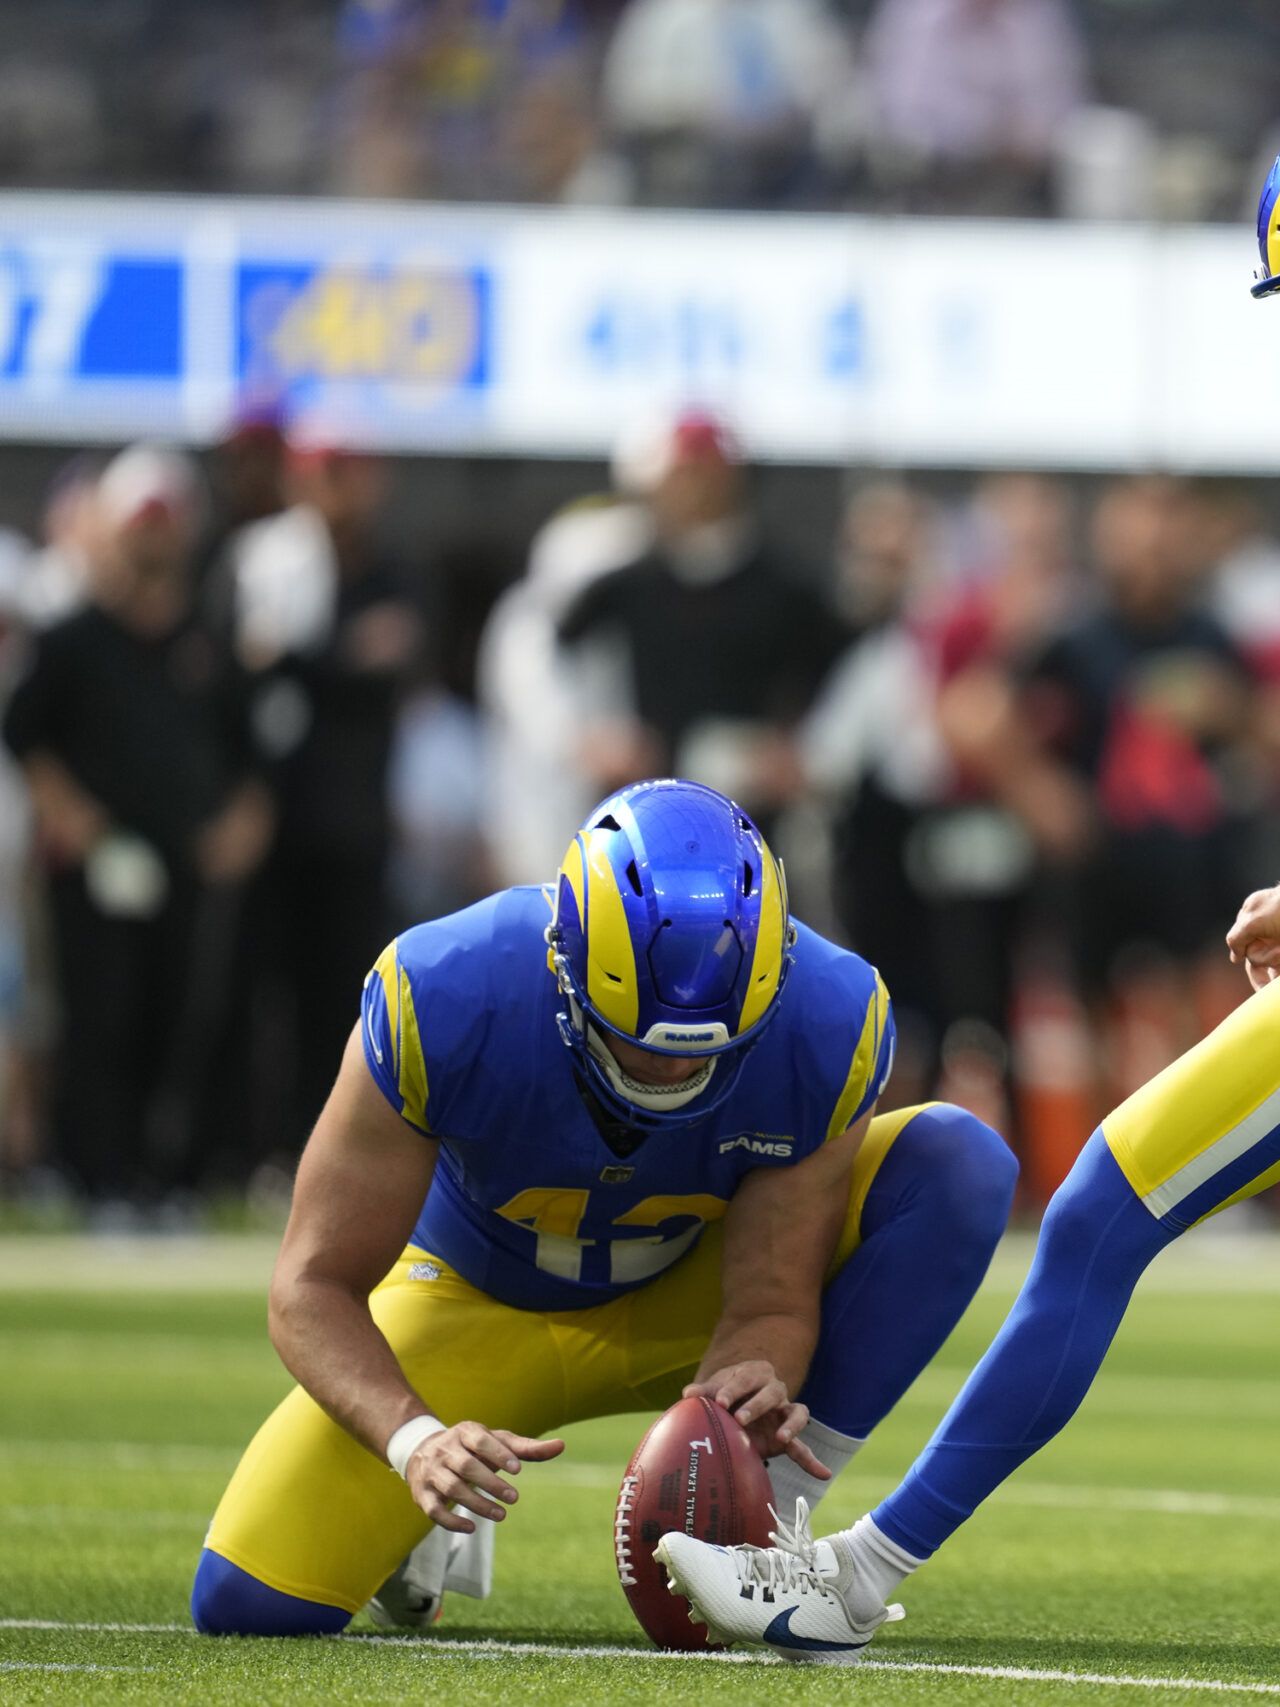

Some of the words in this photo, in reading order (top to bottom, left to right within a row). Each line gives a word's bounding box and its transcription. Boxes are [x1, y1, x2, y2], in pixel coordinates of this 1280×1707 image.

[664, 1031, 714, 1043] RAMS
[689, 1437, 713, 1455] 1
[687, 1451, 700, 1493] LEAGUE
